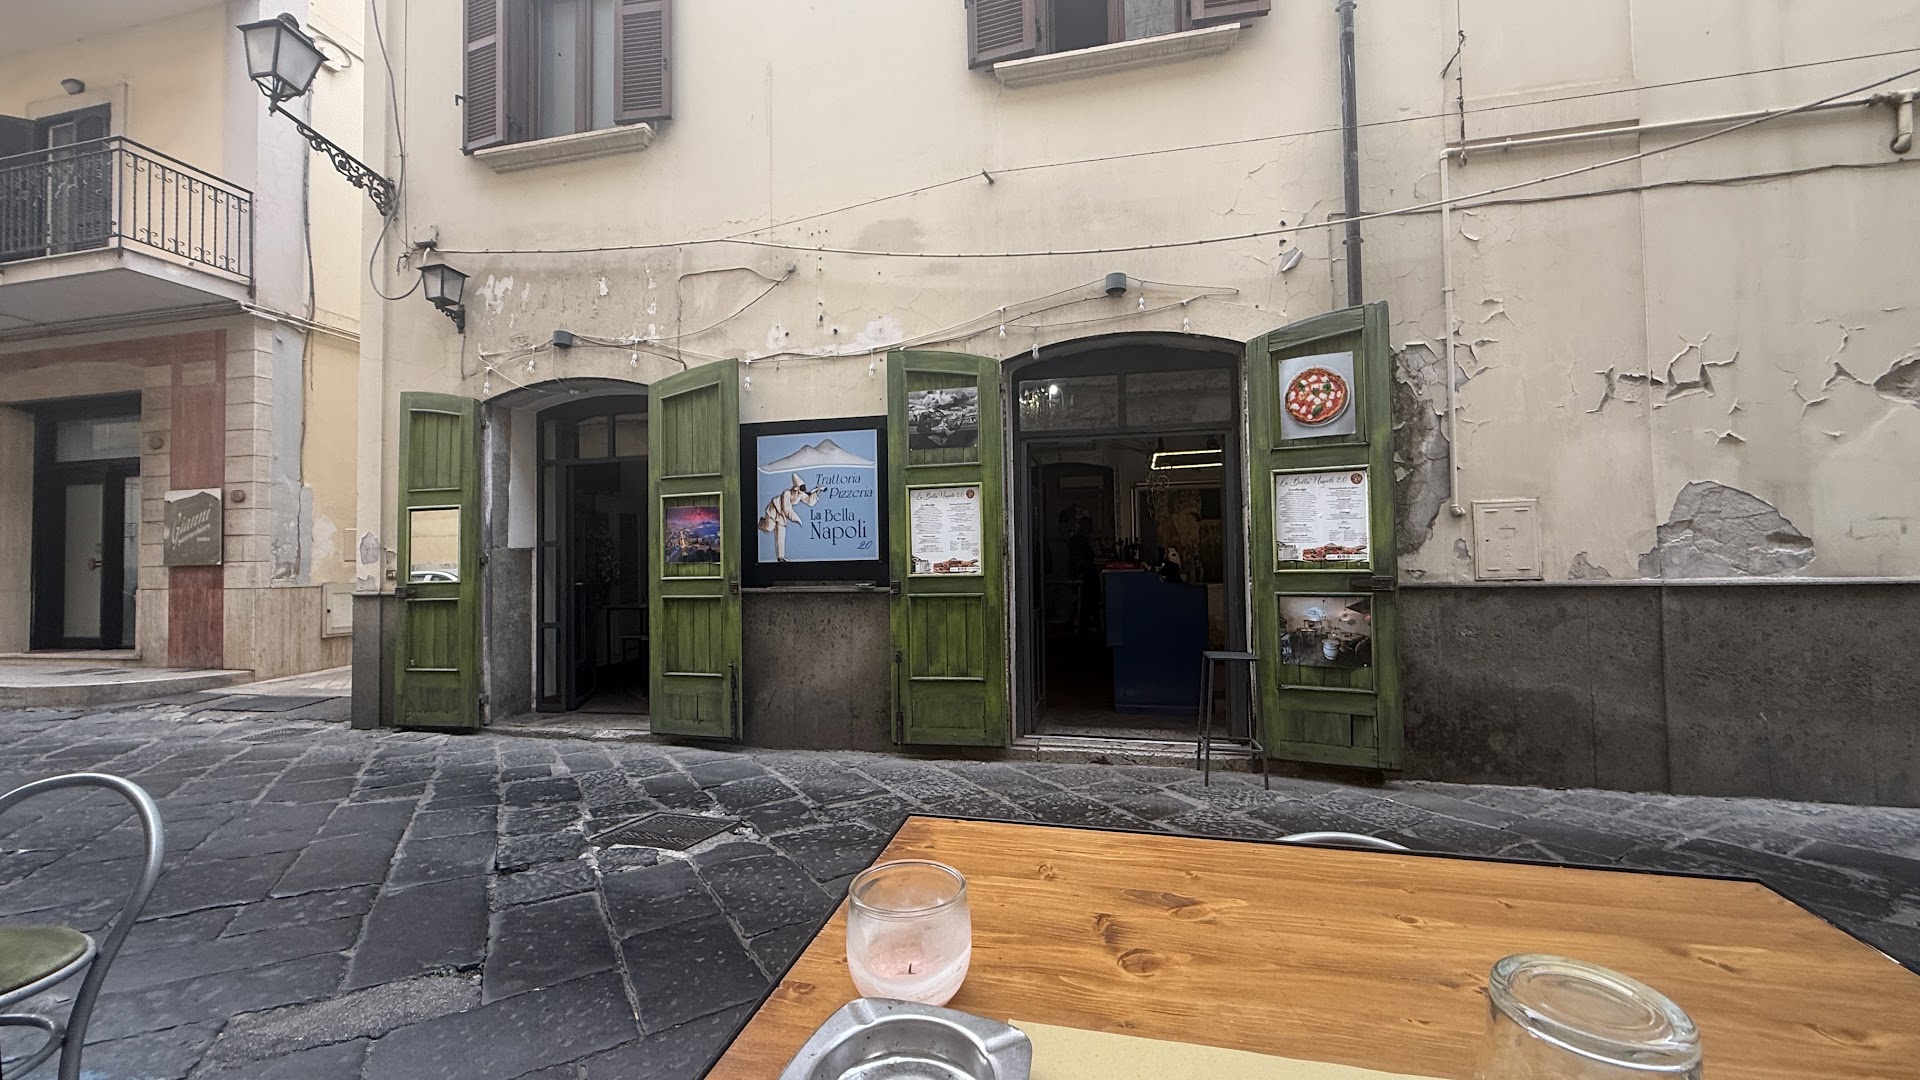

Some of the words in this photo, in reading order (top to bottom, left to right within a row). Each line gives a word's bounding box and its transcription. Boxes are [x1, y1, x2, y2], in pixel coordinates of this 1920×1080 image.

[815, 473, 861, 485] Trattoria
[829, 487, 873, 499] Pizzeria
[810, 509, 822, 521] La
[824, 508, 855, 522] Bella
[810, 519, 867, 545] Napoli
